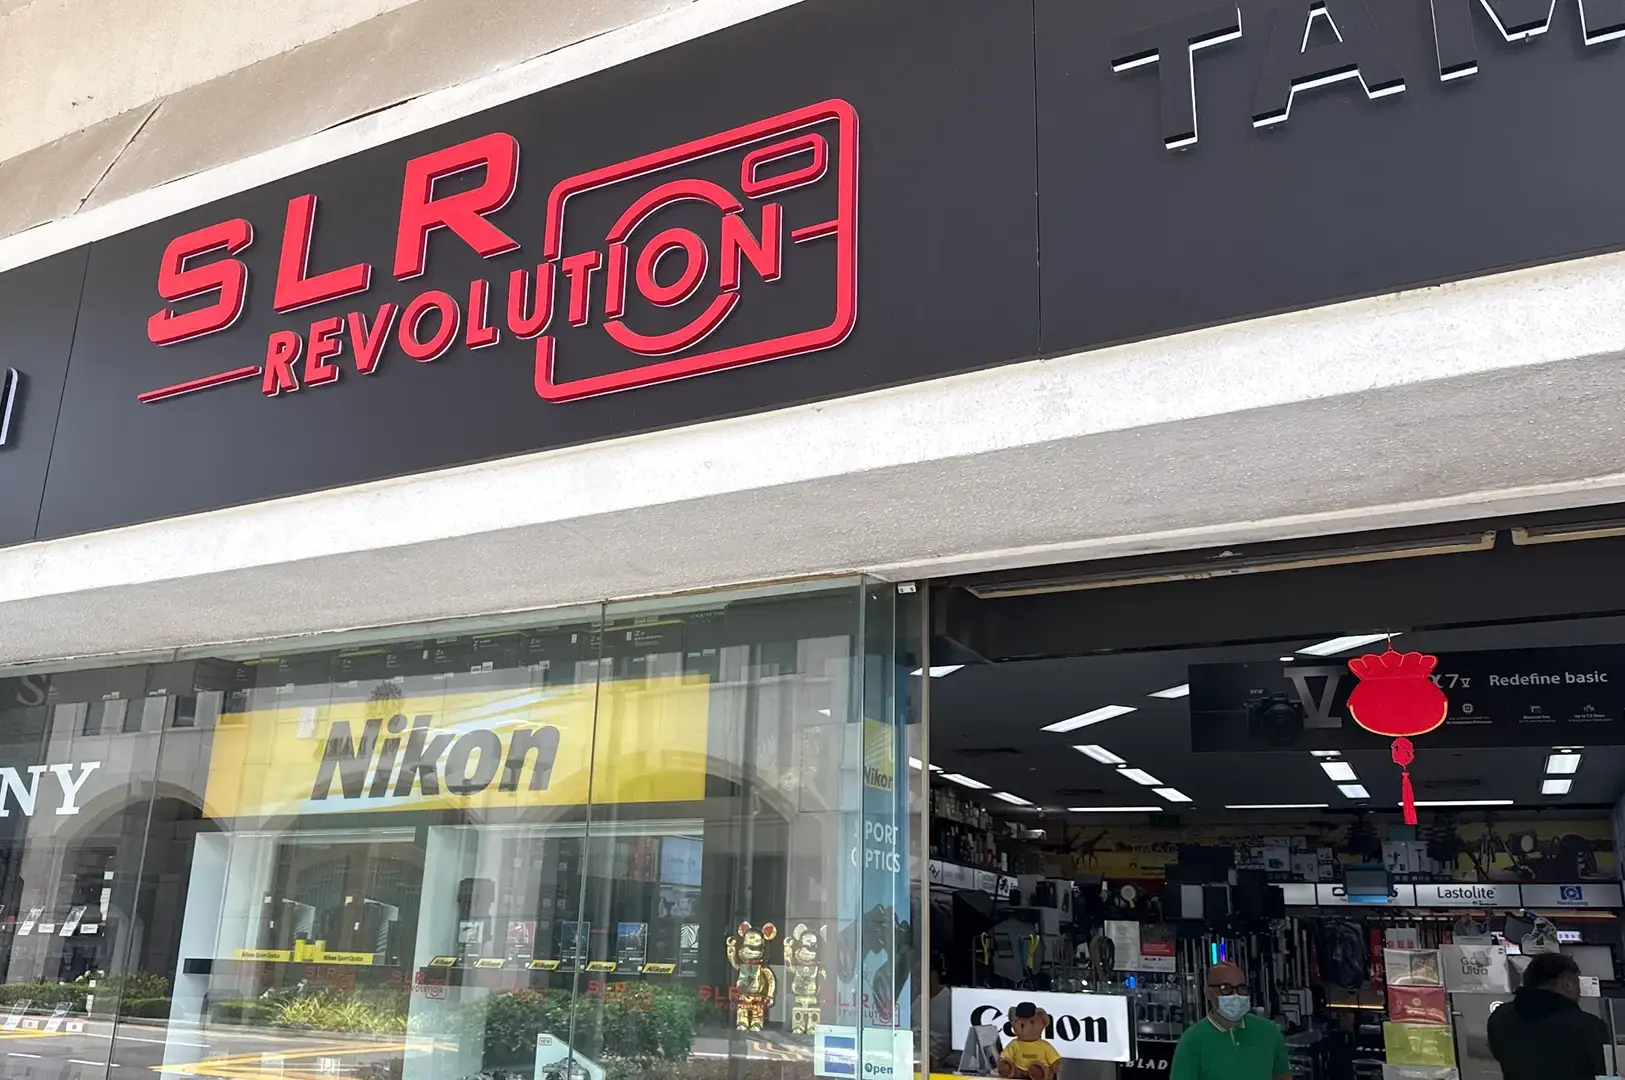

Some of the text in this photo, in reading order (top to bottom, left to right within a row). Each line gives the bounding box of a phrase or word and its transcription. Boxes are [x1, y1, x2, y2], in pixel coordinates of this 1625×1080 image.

[148, 131, 521, 347] SLR
[261, 202, 783, 397] REVOLUTION
[1489, 670, 1608, 687] Redefine basic
[310, 714, 561, 801] Nikon
[590, 963, 613, 971] Nikon
[1462, 965, 1488, 976] Ultra
[864, 1062, 893, 1075] Open
[1120, 1058, 1168, 1070] BLAD
